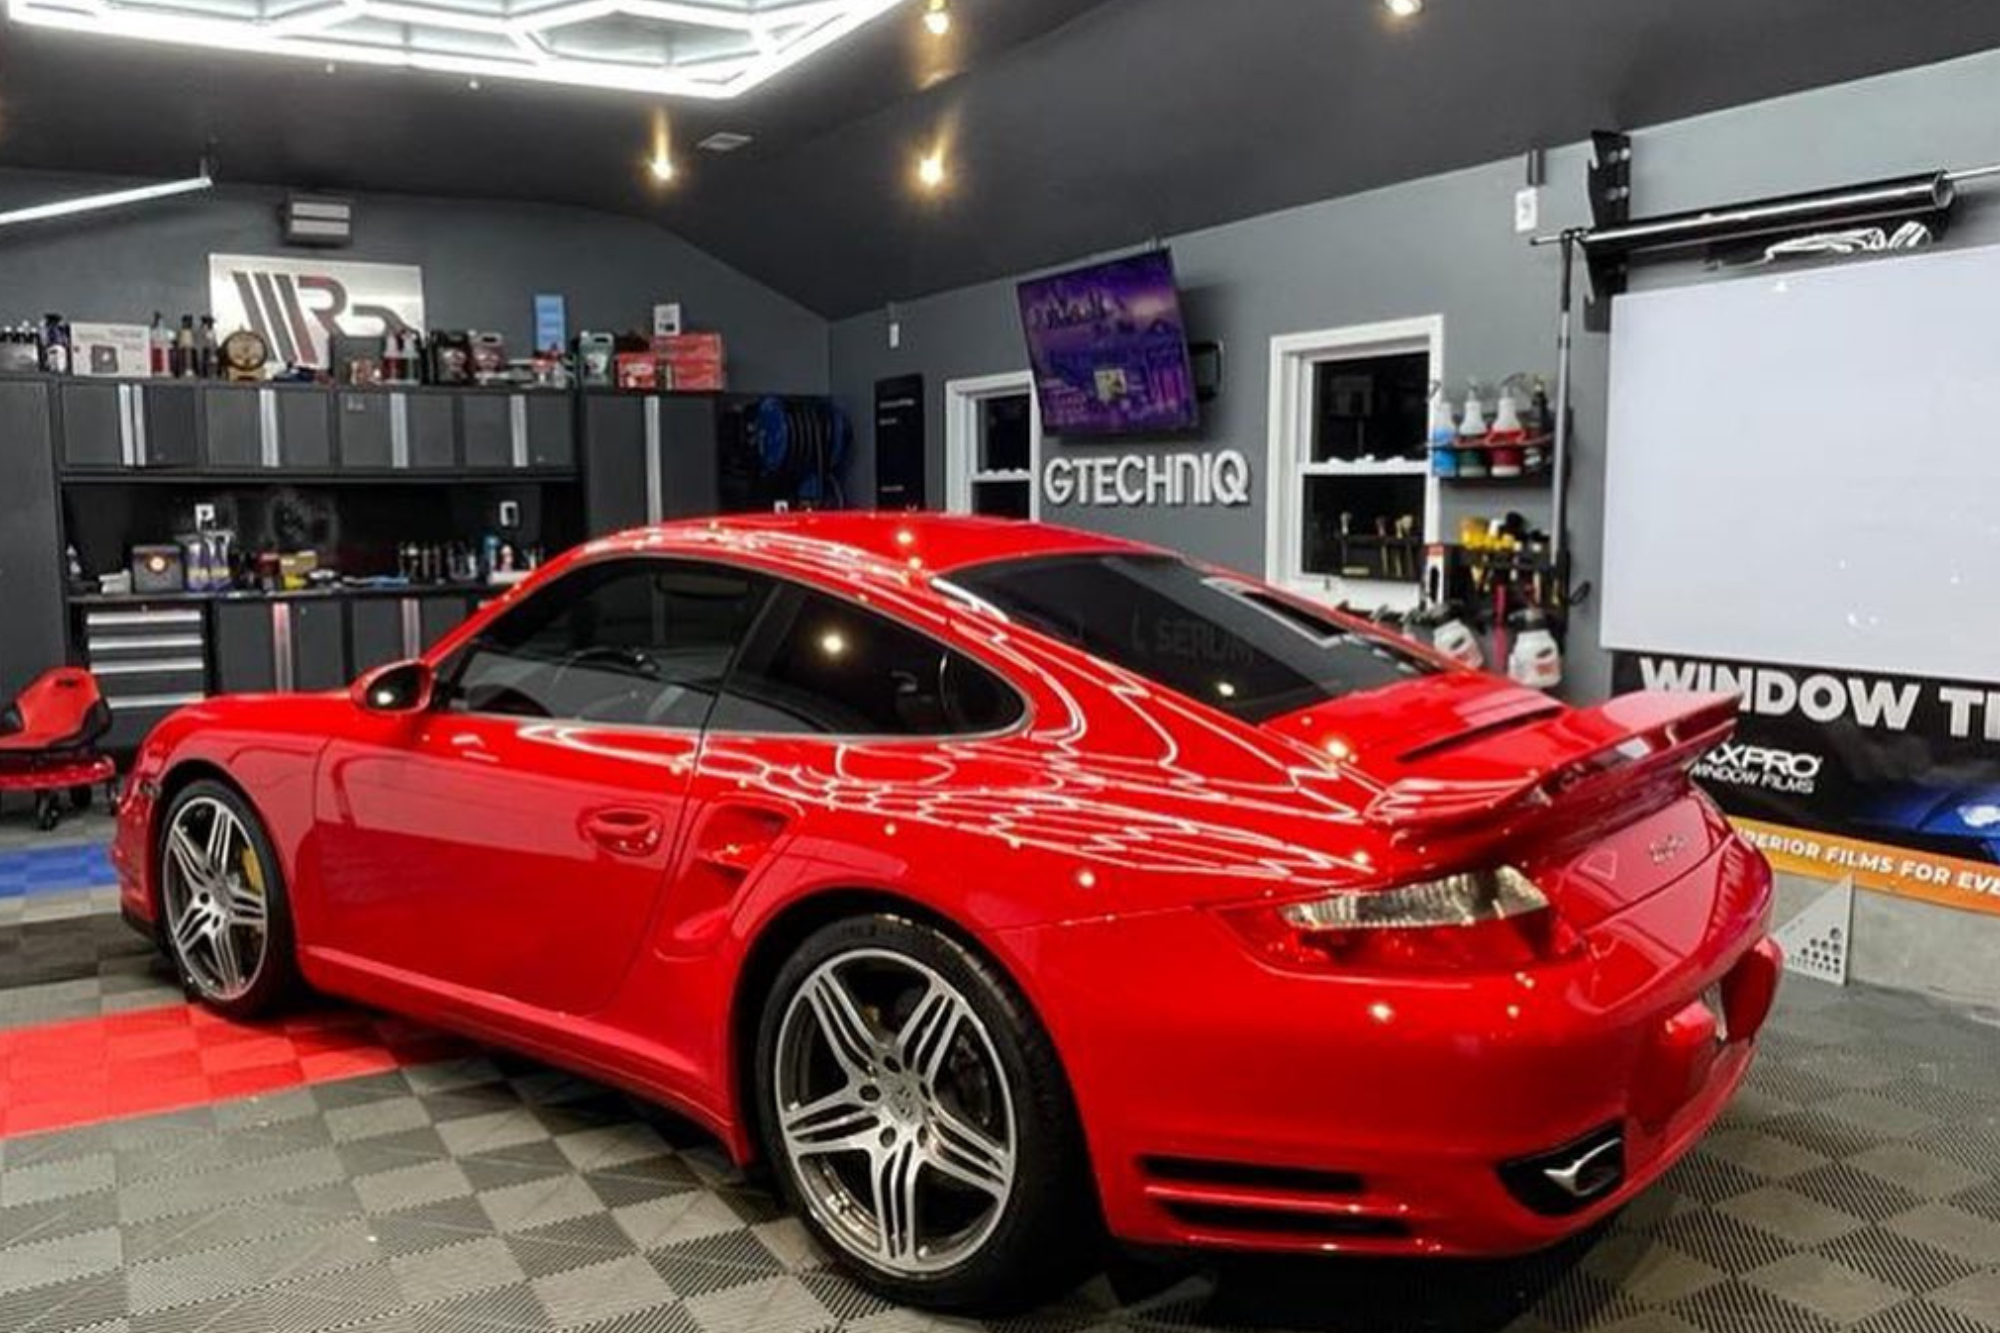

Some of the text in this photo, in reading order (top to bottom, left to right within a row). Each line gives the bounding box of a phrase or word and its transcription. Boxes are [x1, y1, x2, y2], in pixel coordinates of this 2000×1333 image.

[1044, 450, 1248, 504] GTECHNIQ
[1639, 656, 1921, 731] WINDOW
[1739, 828, 1820, 859] PERIOR
[1826, 846, 1893, 873] FILMS
[1900, 860, 1951, 885] FOR
